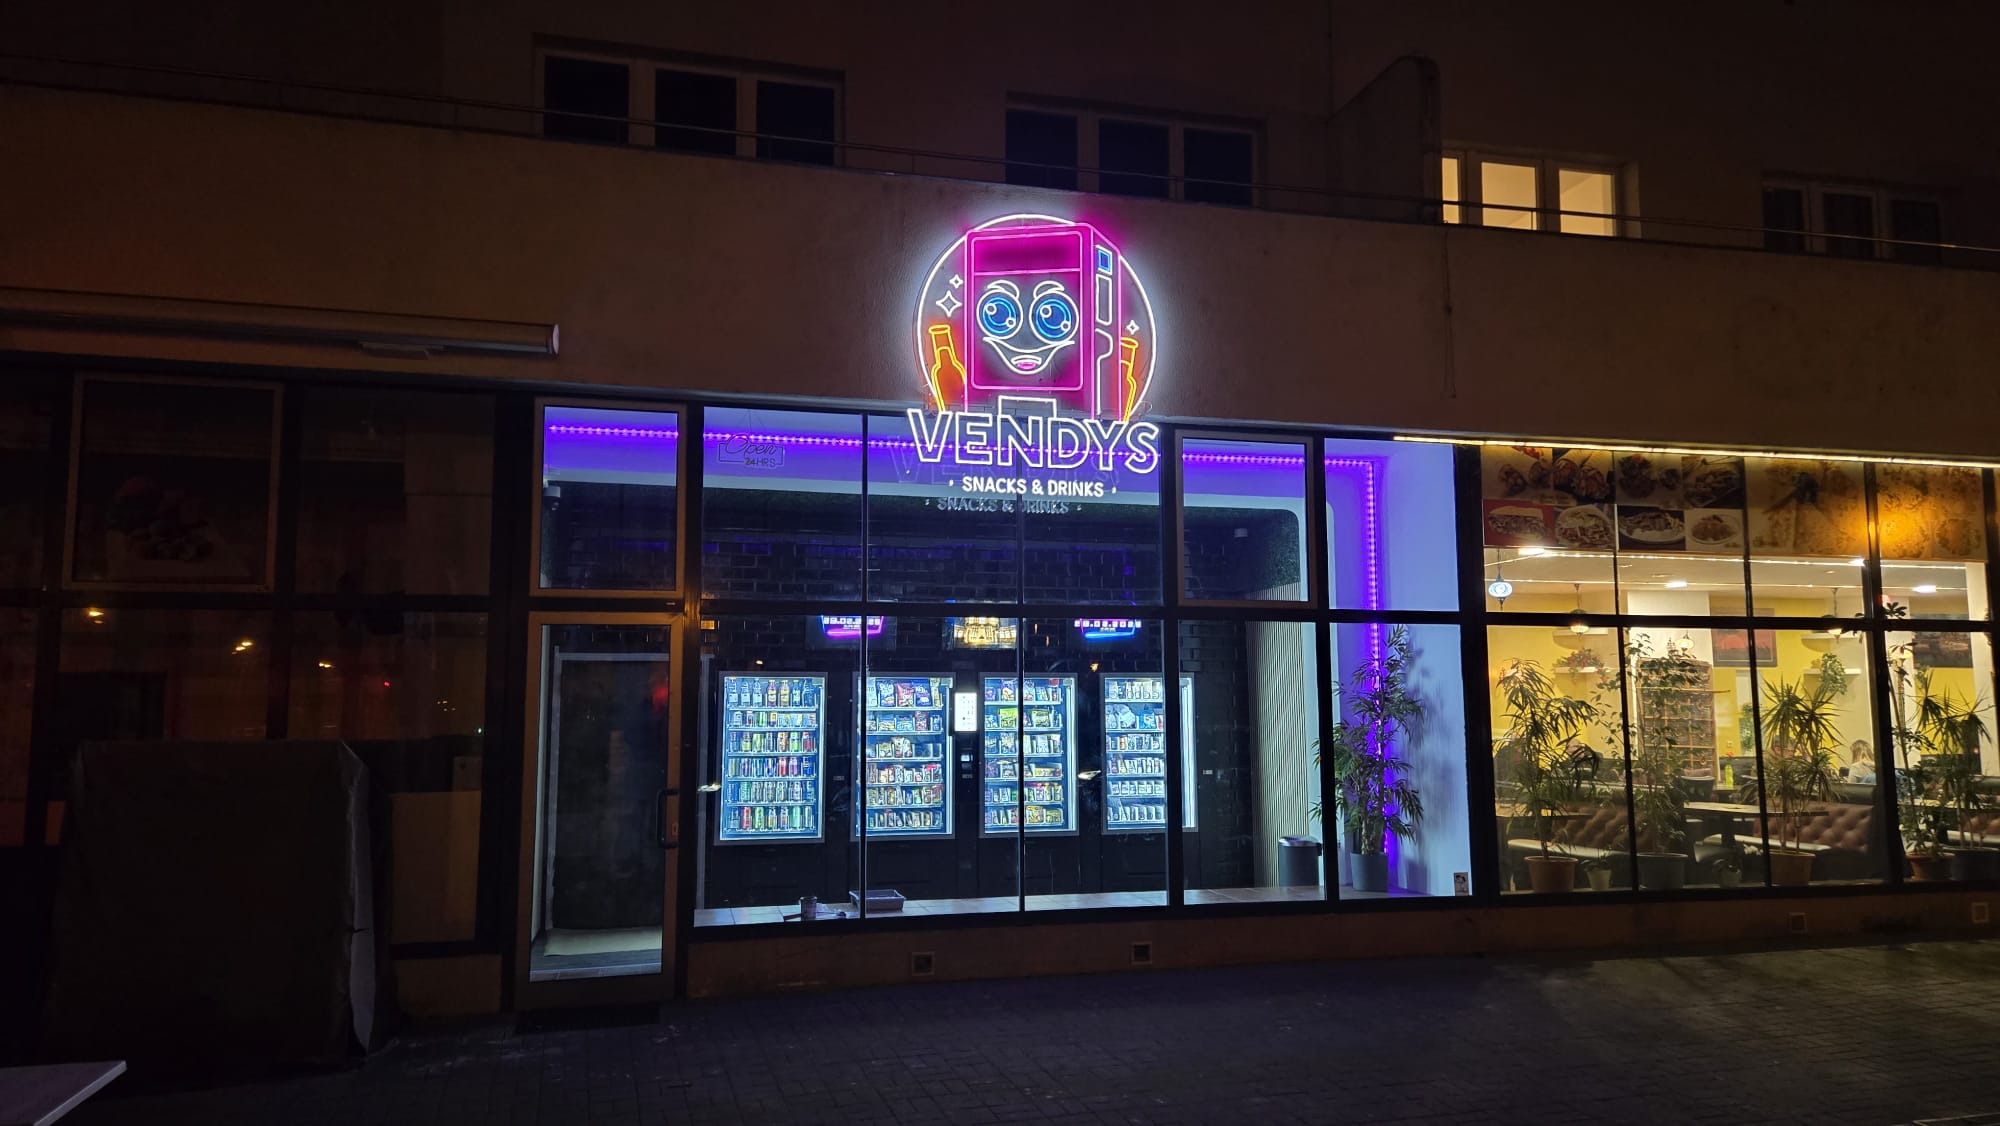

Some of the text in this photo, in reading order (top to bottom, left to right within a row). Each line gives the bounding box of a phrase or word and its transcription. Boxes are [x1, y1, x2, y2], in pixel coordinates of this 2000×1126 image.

[725, 433, 776, 458] Open
[906, 408, 1160, 474] VENDYS
[961, 476, 1104, 497] SNACKS & DRINKS
[936, 496, 998, 512] SNACKS
